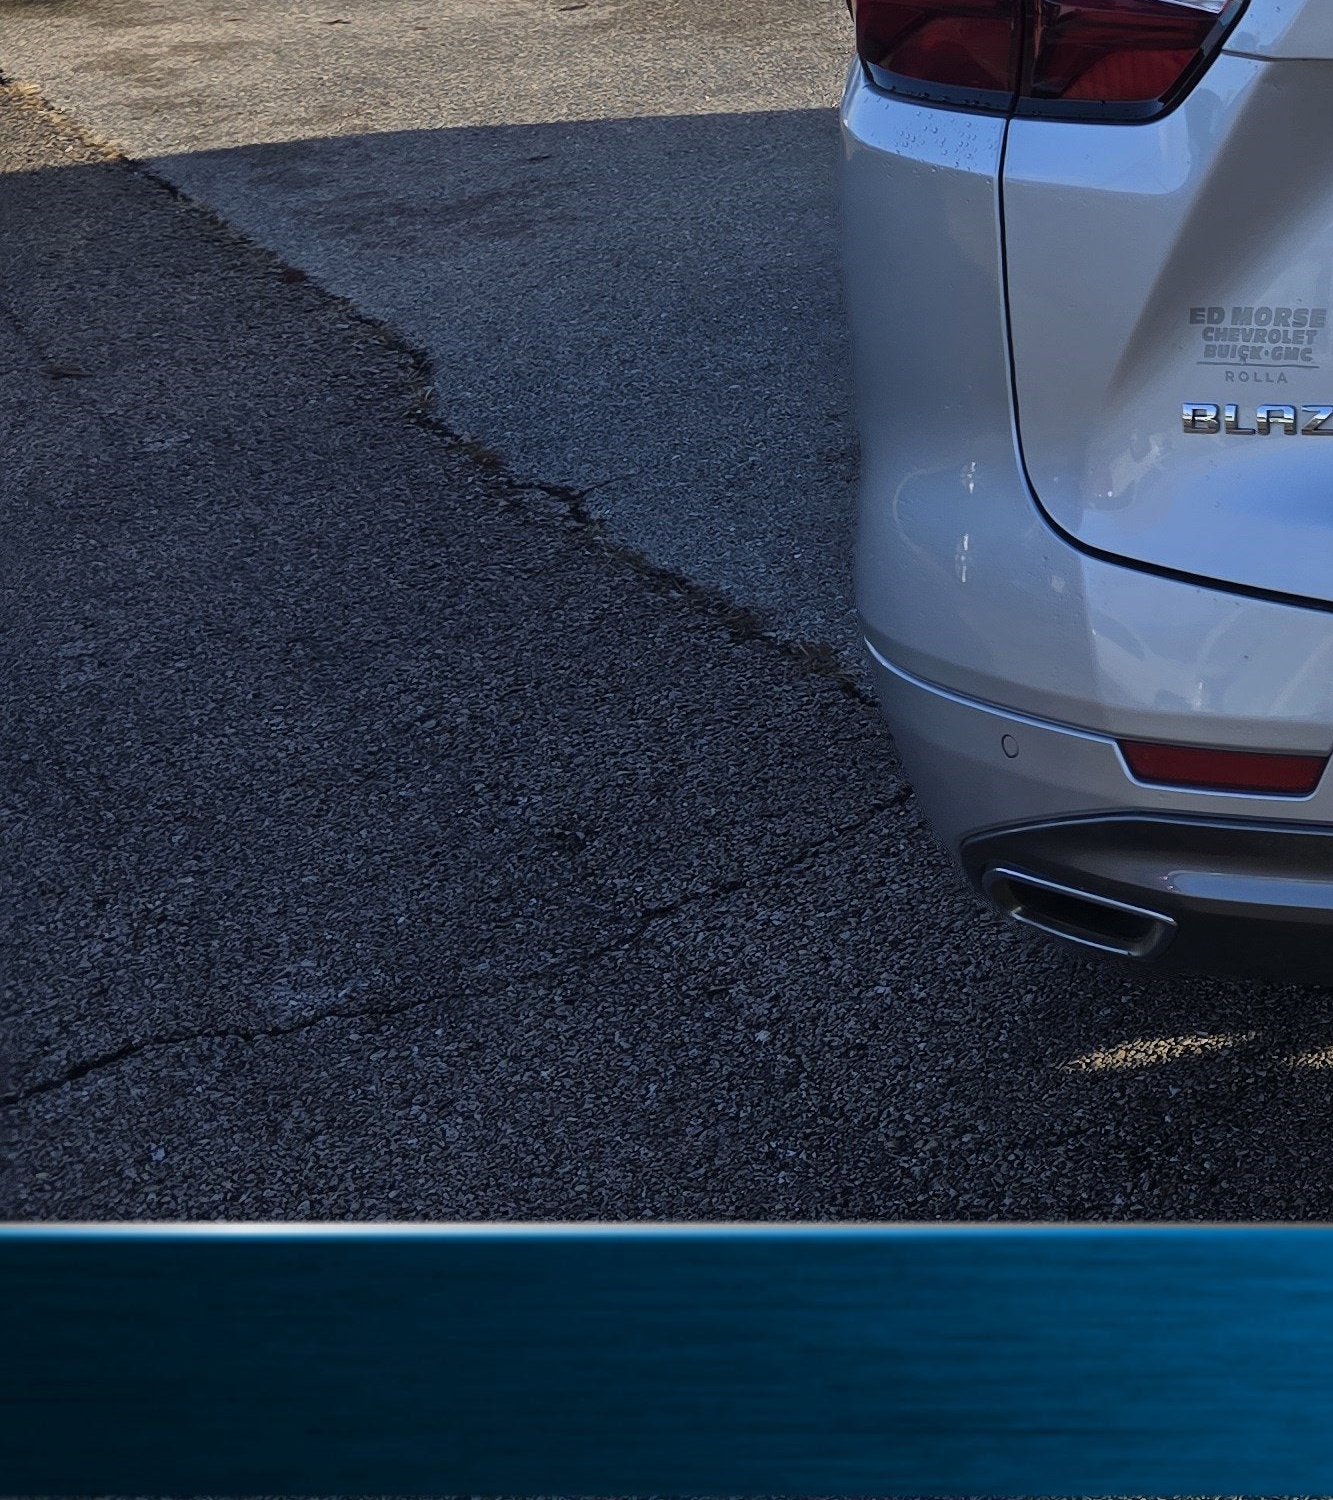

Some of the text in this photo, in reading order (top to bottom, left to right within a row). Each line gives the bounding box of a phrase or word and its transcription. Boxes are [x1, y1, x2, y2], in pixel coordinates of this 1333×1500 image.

[1189, 306, 1327, 329] ED MORSE
[1201, 327, 1317, 345] CHEVROLET
[1224, 370, 1289, 385] ROLLA
